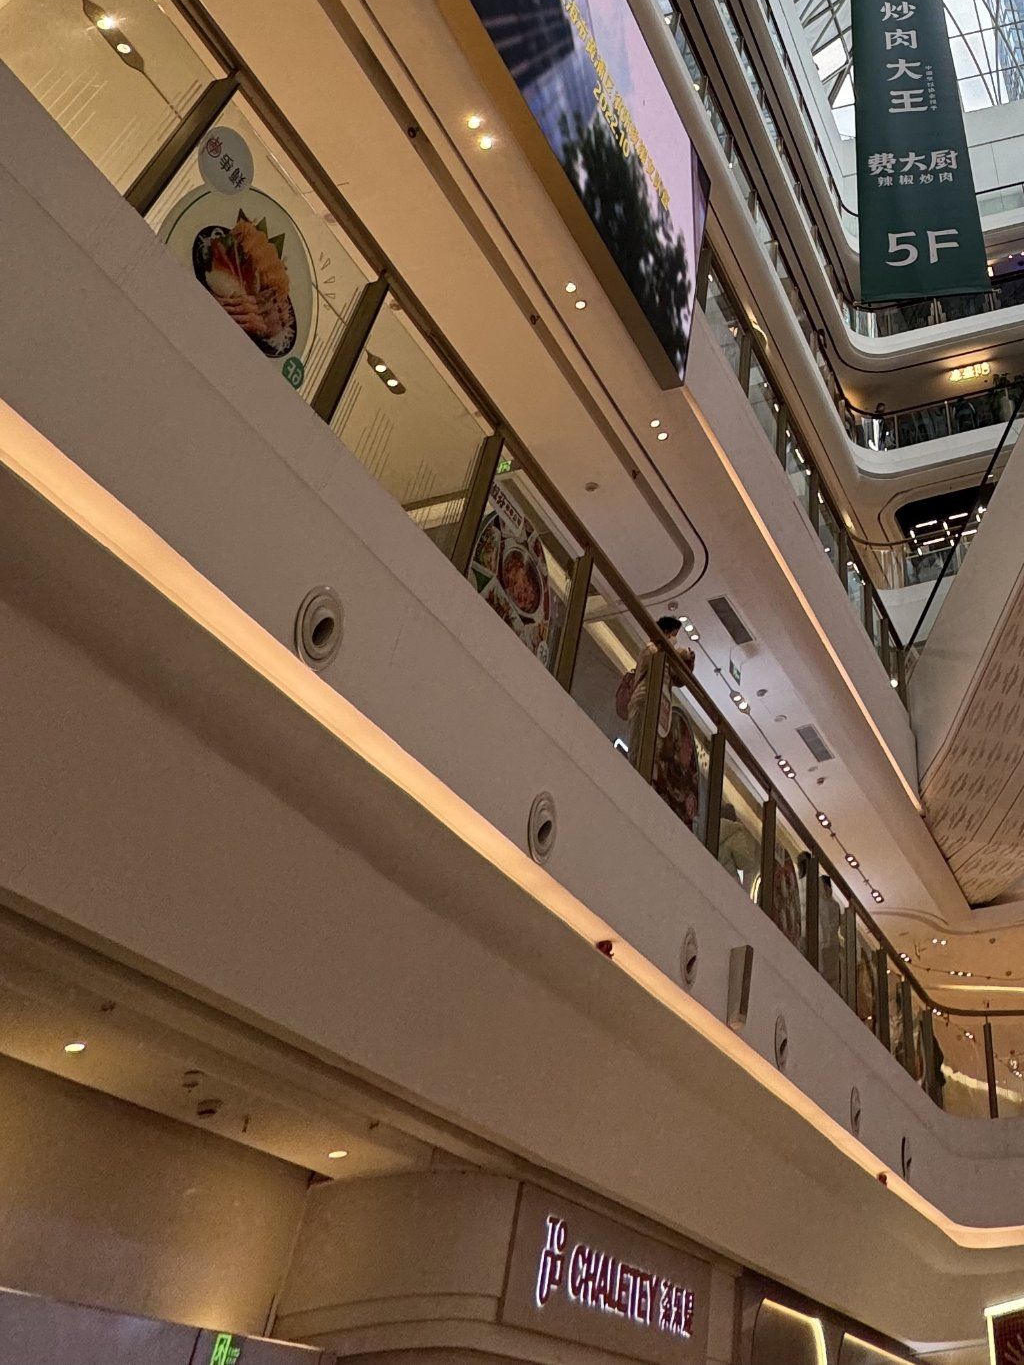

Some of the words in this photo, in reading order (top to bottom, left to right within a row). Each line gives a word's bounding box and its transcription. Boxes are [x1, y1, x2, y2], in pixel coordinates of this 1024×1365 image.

[593, 81, 630, 158] 2022.10
[867, 149, 959, 176] 费大厨
[877, 172, 954, 187] 辣椒炒肉
[885, 228, 960, 267] 5F
